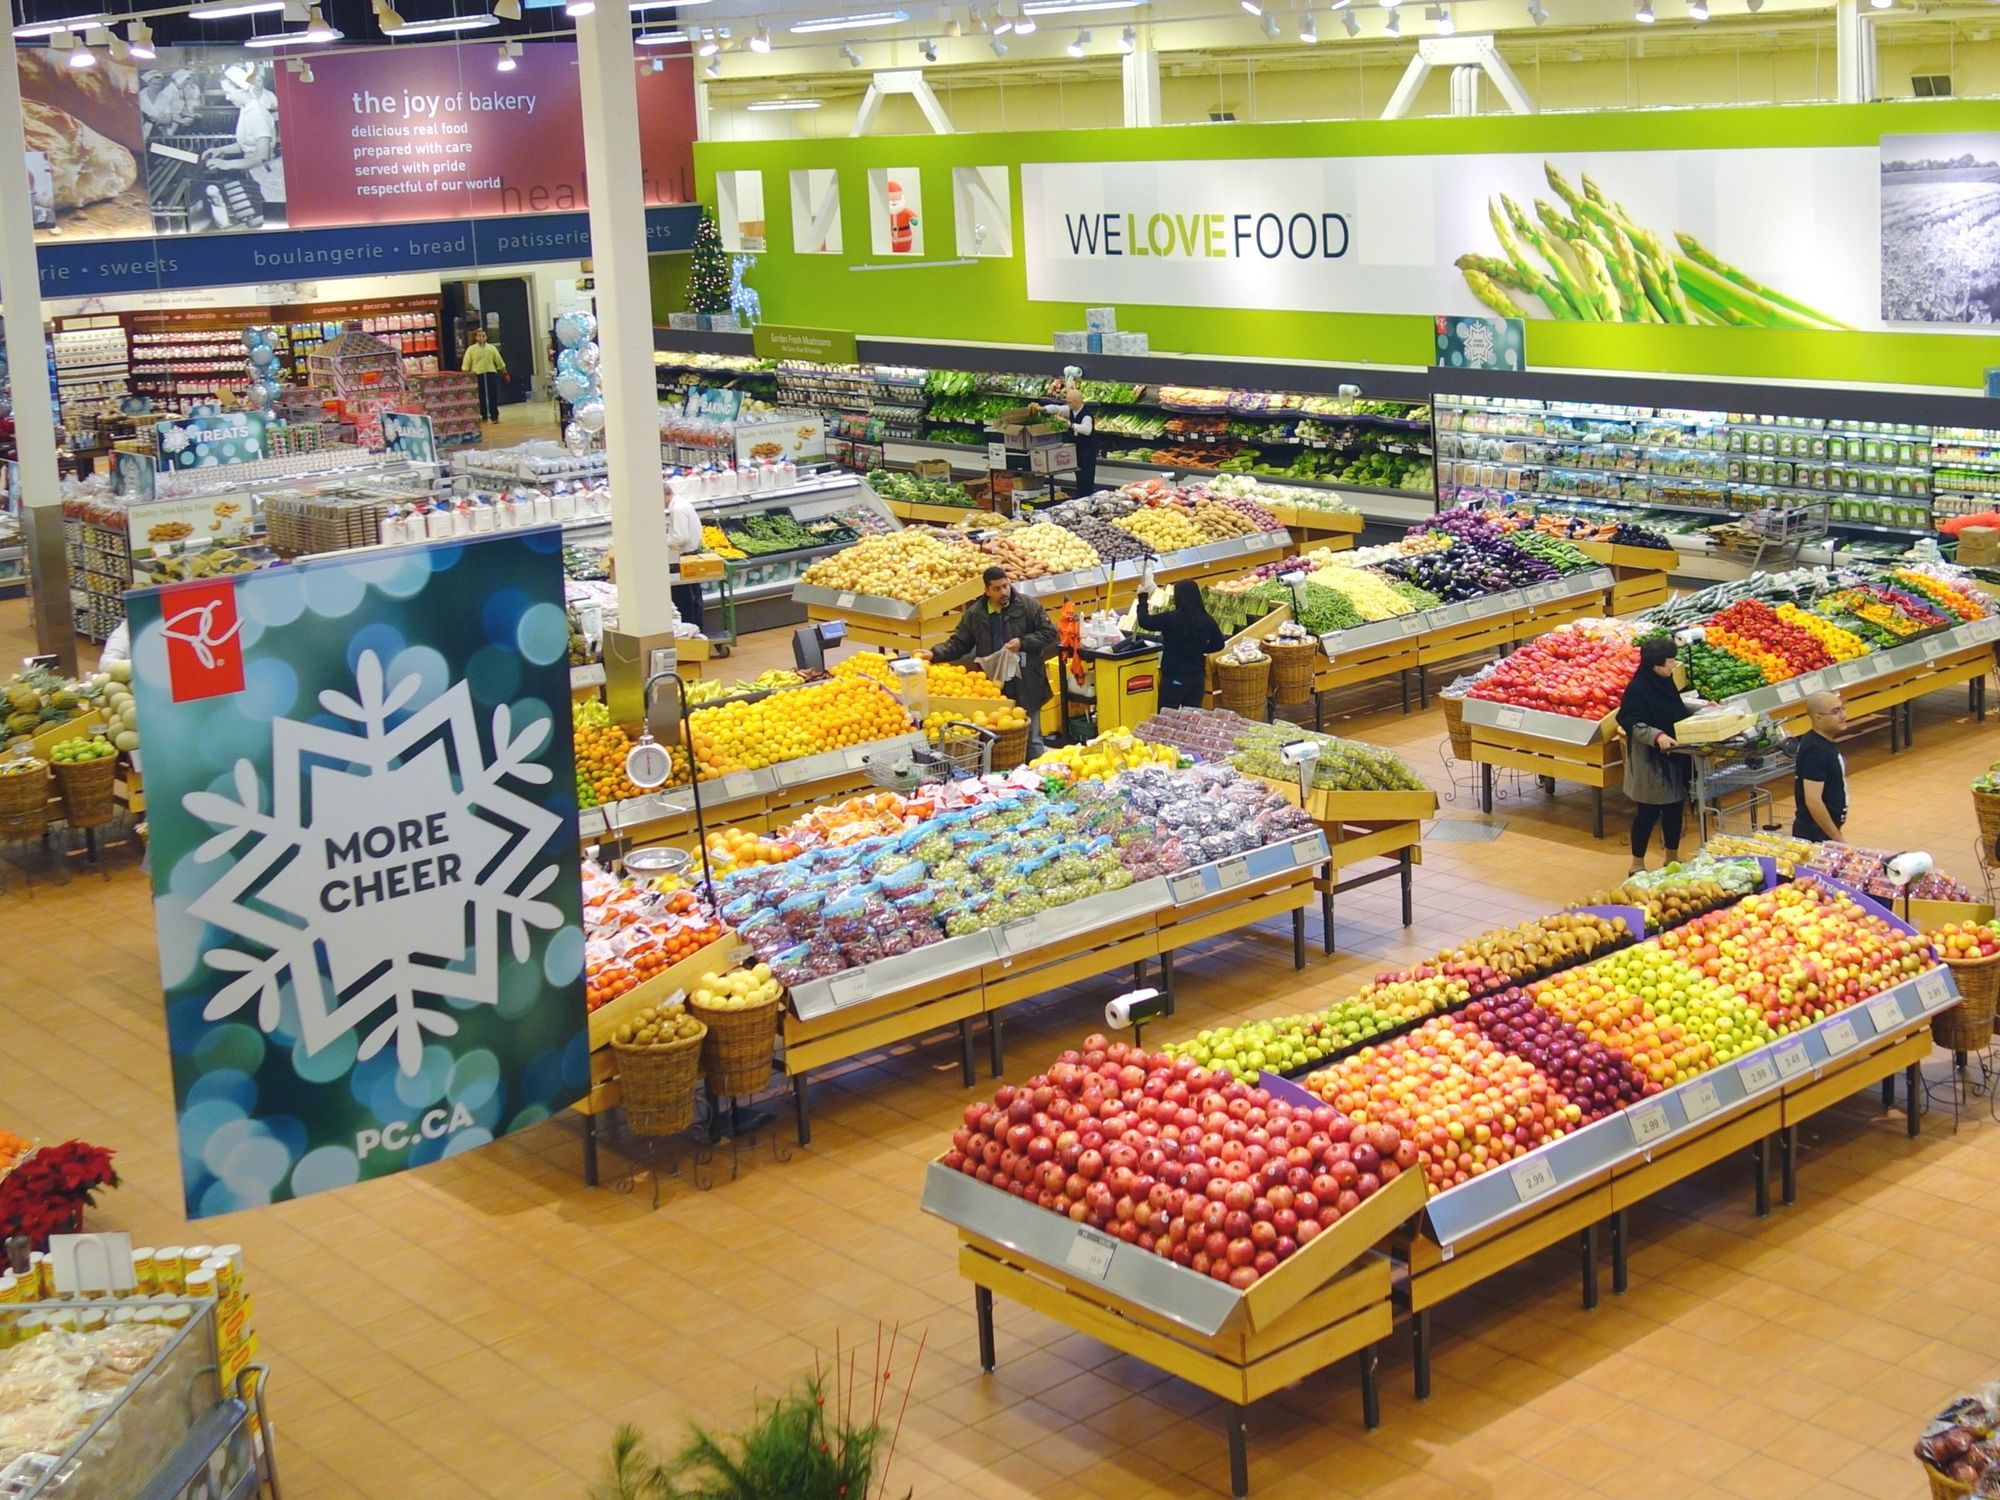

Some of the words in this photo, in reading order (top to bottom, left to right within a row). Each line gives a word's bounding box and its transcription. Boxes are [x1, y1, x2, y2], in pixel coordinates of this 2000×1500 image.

[352, 91, 396, 114] the
[402, 89, 440, 119] joy
[444, 92, 463, 112] of
[469, 92, 536, 114] bakery
[351, 125, 410, 138] delicious
[413, 124, 438, 136] real
[441, 122, 468, 134] food
[353, 143, 411, 160] prepared
[415, 141, 442, 154] with
[446, 143, 472, 153] care
[355, 162, 398, 176] served
[402, 161, 429, 174] with
[433, 160, 466, 176] pride
[357, 180, 422, 198] respectful
[425, 179, 437, 192] of
[441, 180, 463, 191] our
[465, 176, 501, 190] world
[1065, 212, 1122, 256] WE
[1127, 212, 1227, 258] LOVE
[1233, 212, 1350, 260] FOOD
[254, 243, 383, 266] boulangerie
[409, 236, 465, 256] bread
[498, 229, 589, 252] patisserie
[99, 257, 179, 277] sweets
[701, 401, 732, 415] BAKING
[195, 425, 249, 443] TREATS
[324, 811, 449, 870] MORE
[319, 853, 462, 913] CHEER
[355, 1102, 475, 1160] PC.CA
[1642, 1118, 1660, 1134] 2.99
[1526, 1171, 1545, 1189] 2.99
